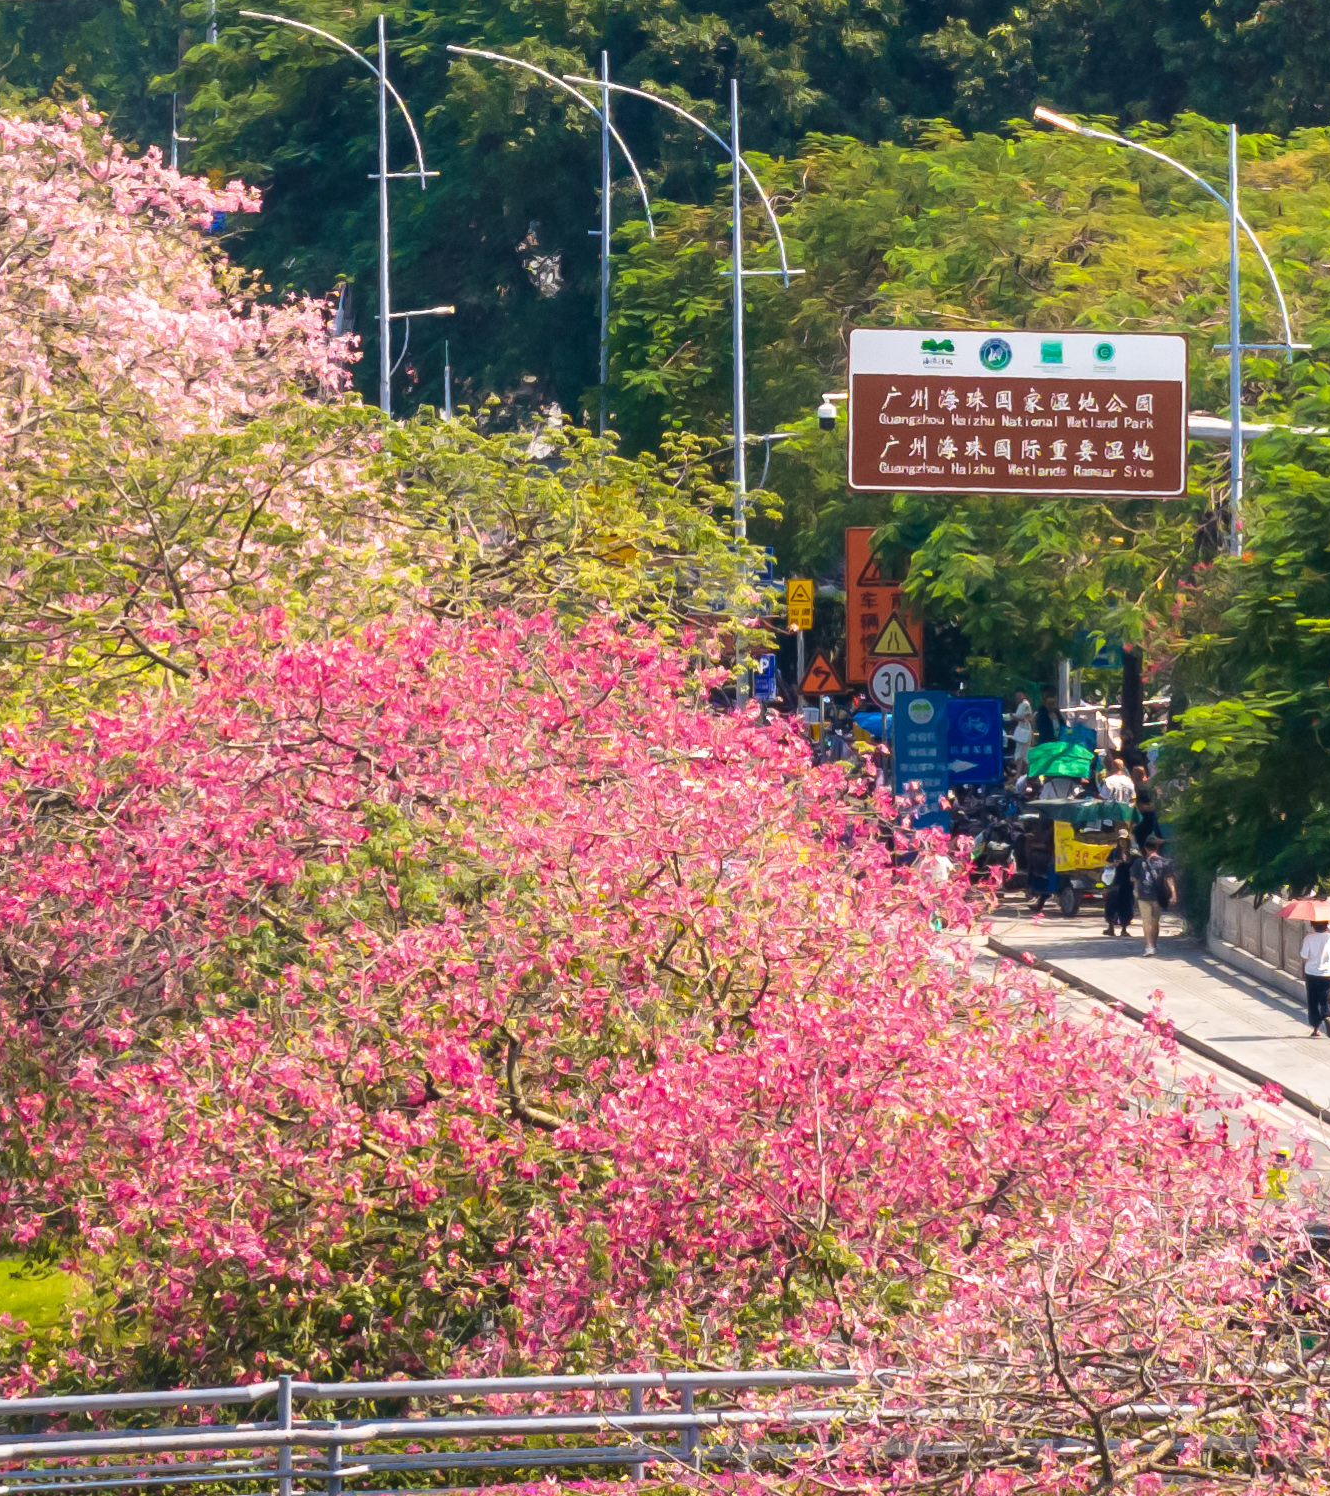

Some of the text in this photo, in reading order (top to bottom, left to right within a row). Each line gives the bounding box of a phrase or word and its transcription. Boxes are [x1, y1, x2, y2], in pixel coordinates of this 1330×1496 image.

[881, 385, 1153, 414] 广州海珠国家湿地公园
[879, 412, 1154, 429] Guangzhou Haizhu National Wetland Park
[879, 434, 1154, 462] 广州海珠国际重要湿地
[879, 461, 945, 476] Guangzhou
[950, 462, 996, 475] Haizhu
[1008, 463, 1068, 477] Wetlands
[1123, 464, 1154, 478] Site
[880, 671, 907, 697] 30
